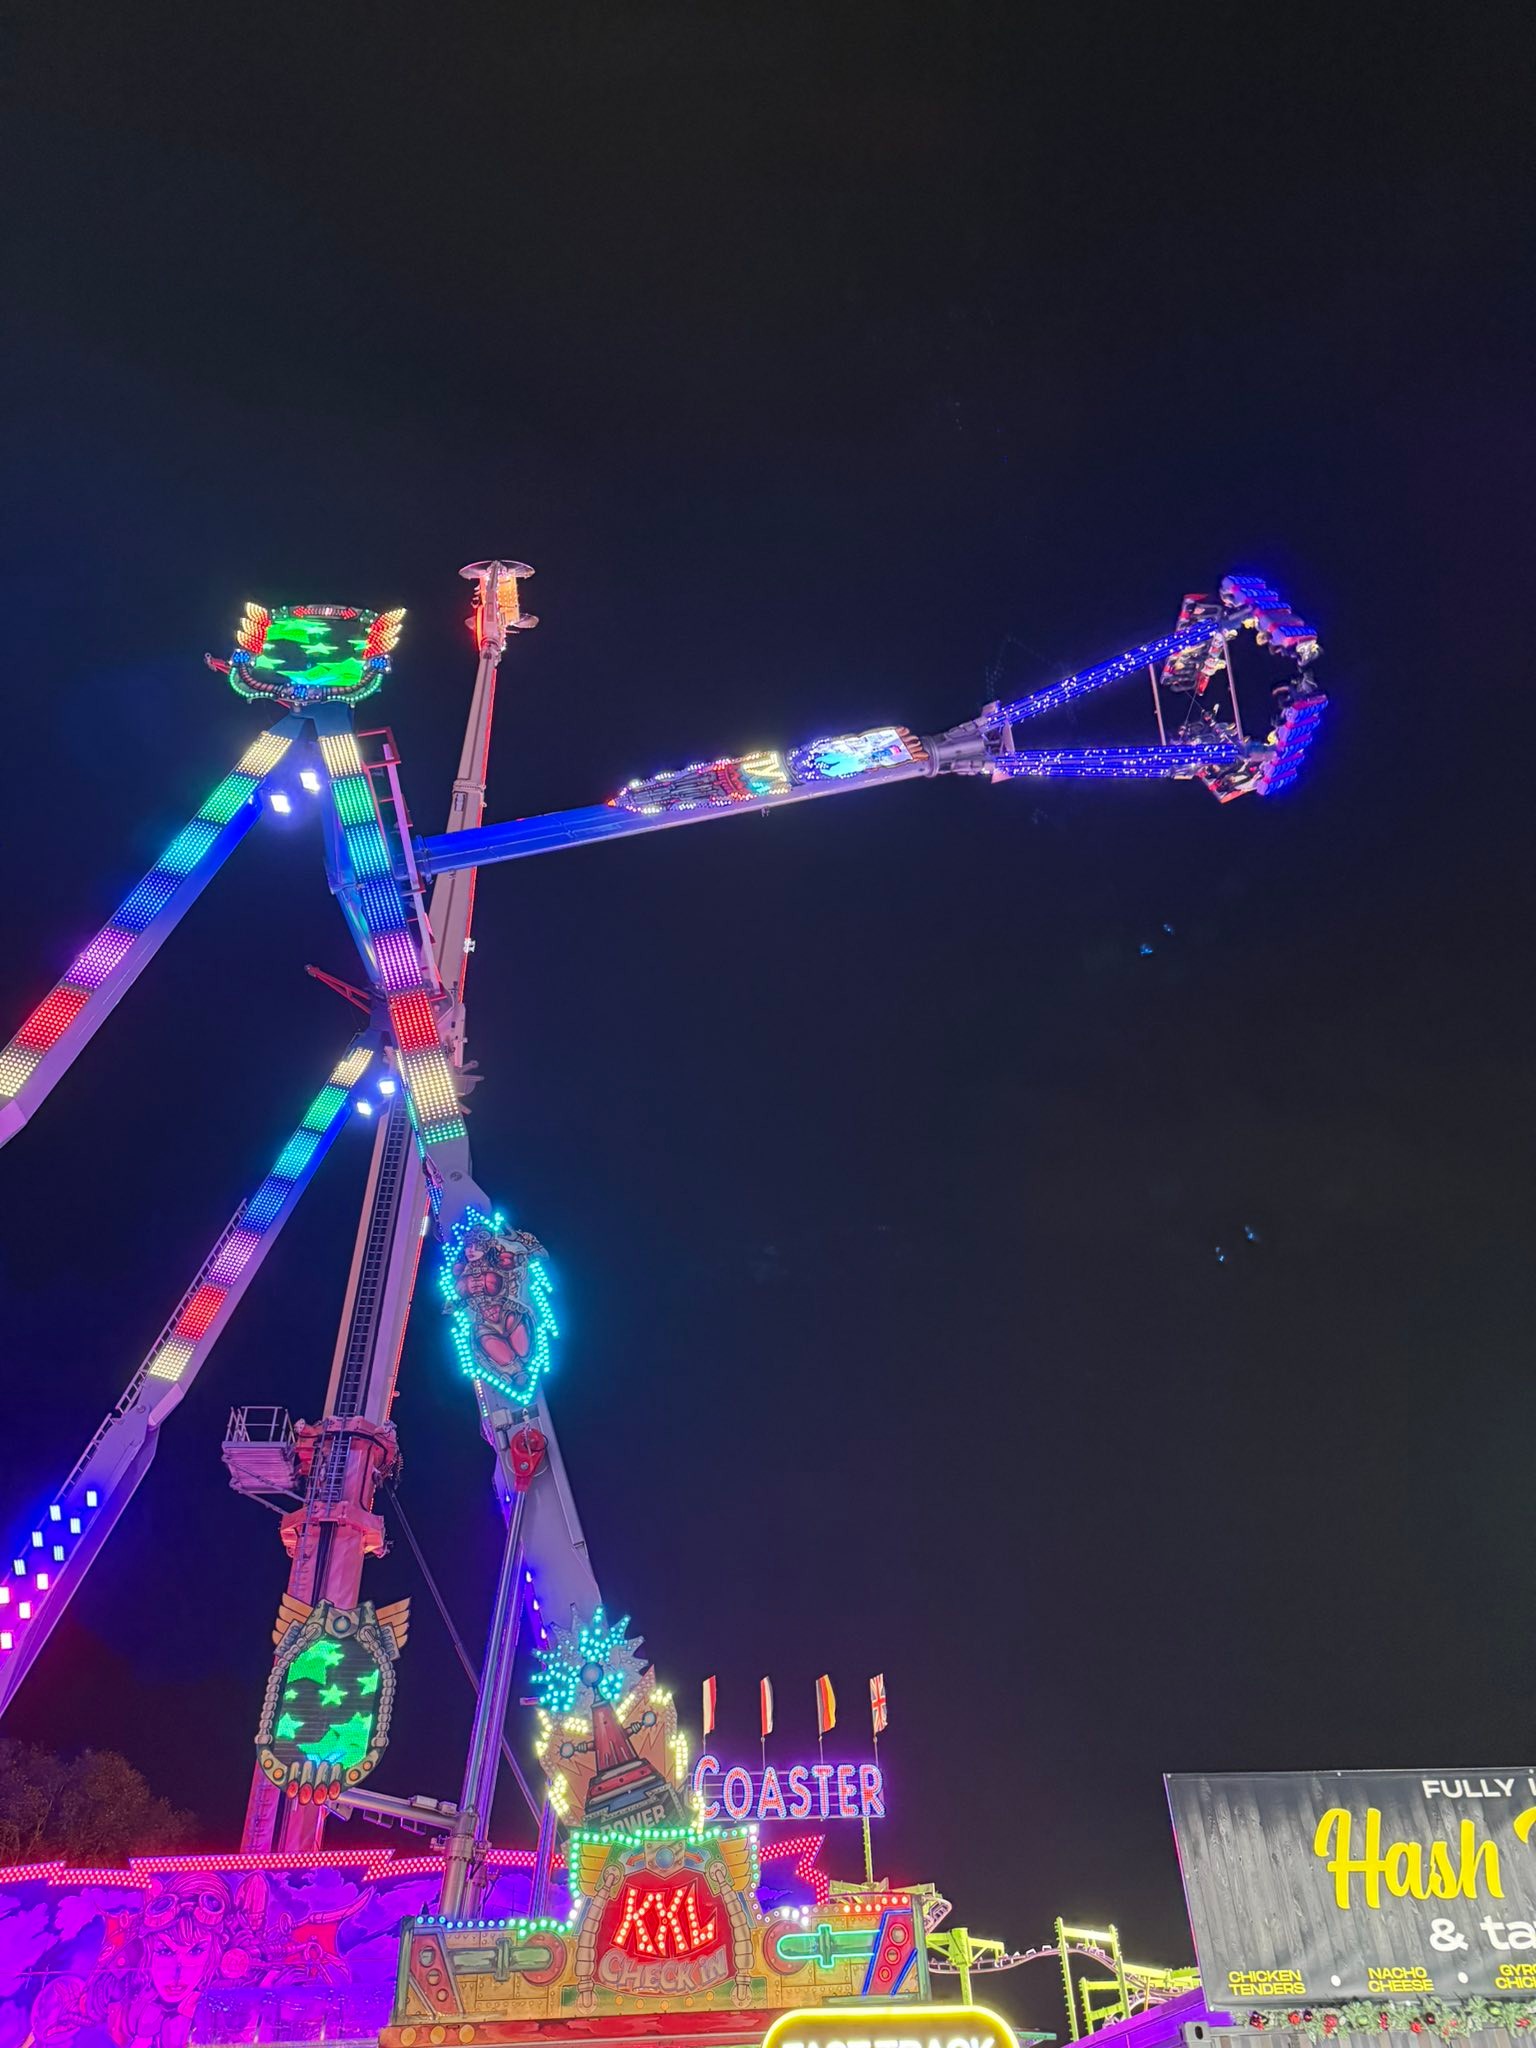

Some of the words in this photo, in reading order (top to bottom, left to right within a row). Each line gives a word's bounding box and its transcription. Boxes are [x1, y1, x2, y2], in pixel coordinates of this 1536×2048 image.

[692, 1755, 886, 1820] COASTER
[1422, 1778, 1515, 1799] FULLY
[1314, 1807, 1505, 1910] Hash
[1429, 1918, 1469, 1952] &
[1479, 1915, 1536, 1950] ta
[599, 1949, 698, 1993] CHECK
[1228, 1969, 1302, 1984] CHICKEN
[1367, 1966, 1427, 1980] NACHO
[1228, 1983, 1306, 1997] TENDERS
[1368, 1979, 1435, 1993] CHEESE
[1495, 1976, 1536, 1990] CHIC
